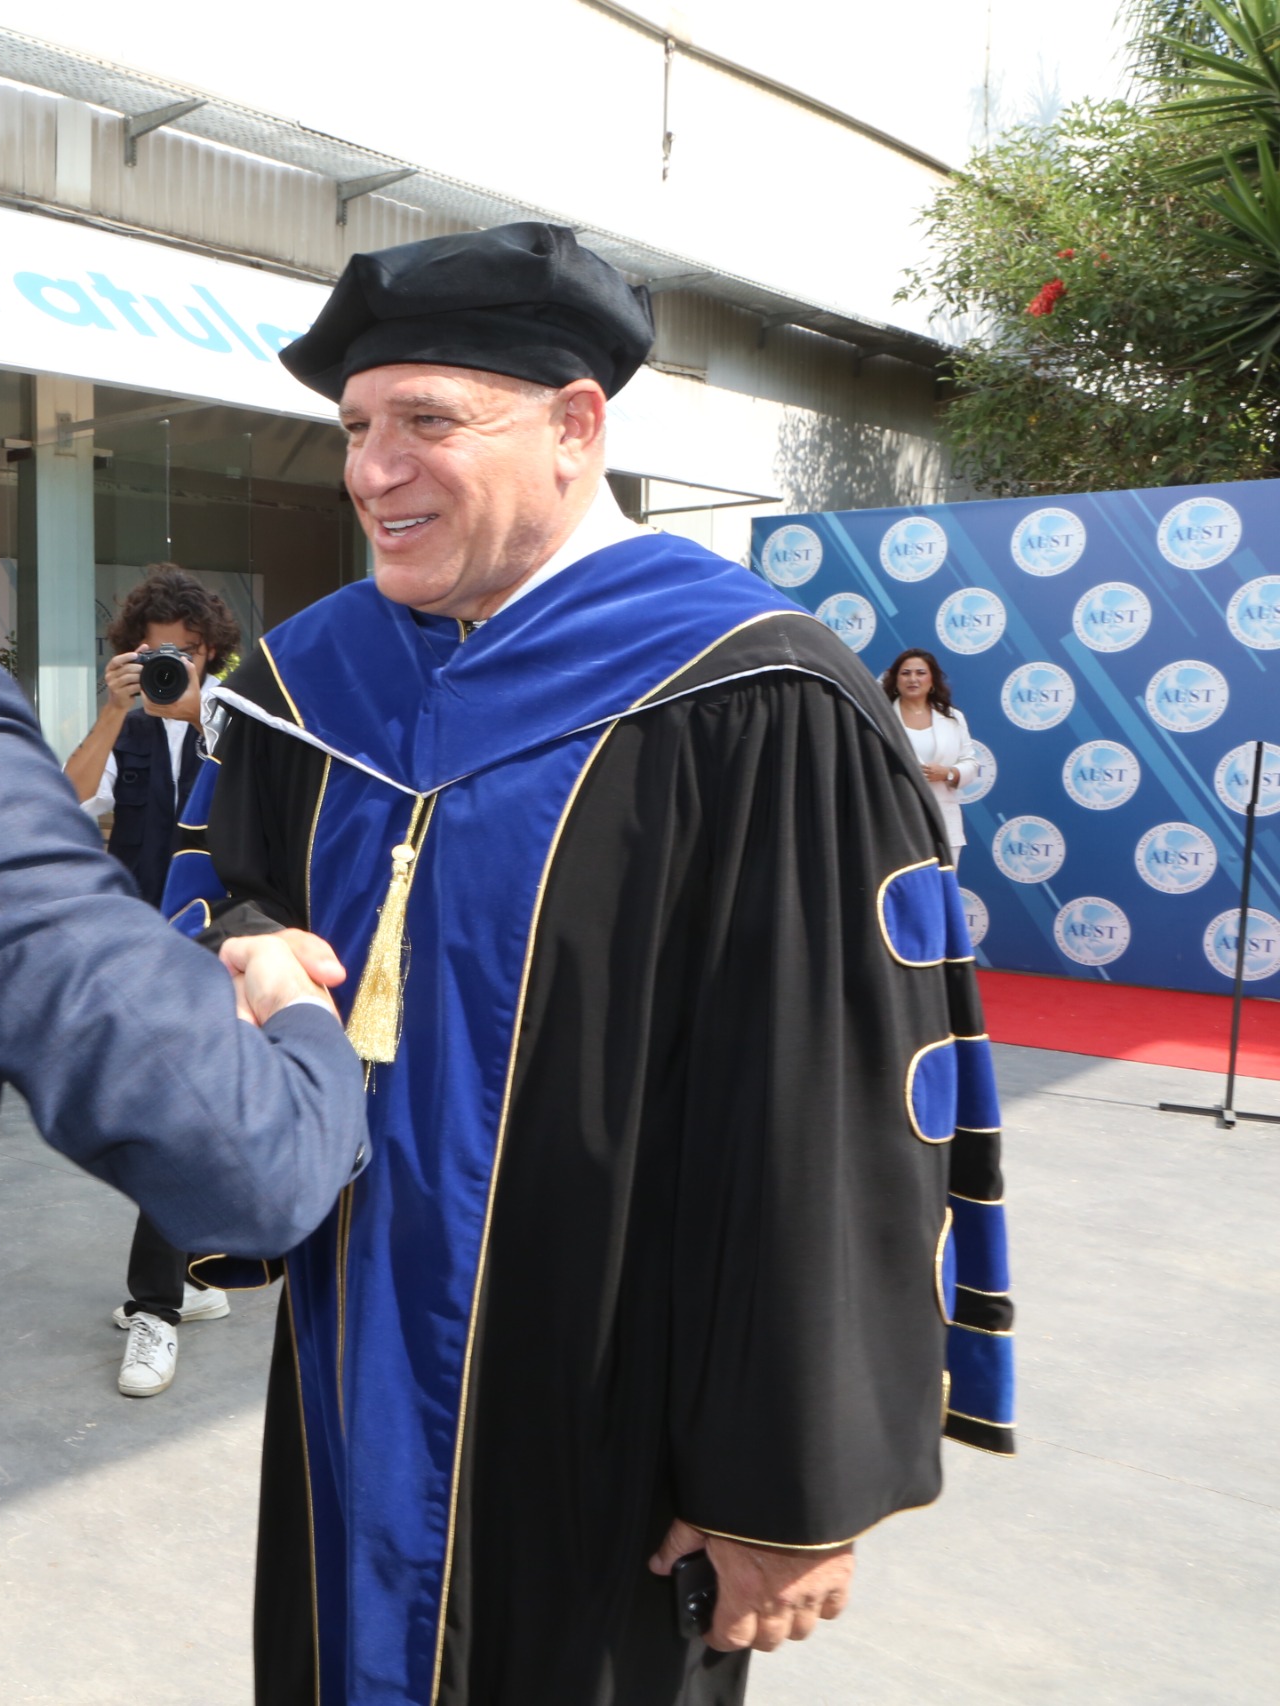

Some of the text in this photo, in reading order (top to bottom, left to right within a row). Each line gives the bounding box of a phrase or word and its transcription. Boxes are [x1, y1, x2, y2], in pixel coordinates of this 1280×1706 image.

[1170, 523, 1228, 541] AUST
[891, 541, 936, 556] AUST
[1023, 534, 1074, 550] AUST
[772, 548, 813, 562] AUST
[948, 614, 995, 628] AUST
[1085, 609, 1140, 624] AUST
[1012, 689, 1064, 703] AUST
[1157, 688, 1216, 703] AUST
[1074, 768, 1129, 782] AUST
[1004, 843, 1054, 857] AUST
[1147, 850, 1204, 866] AUST
[1067, 925, 1119, 939] AUST
